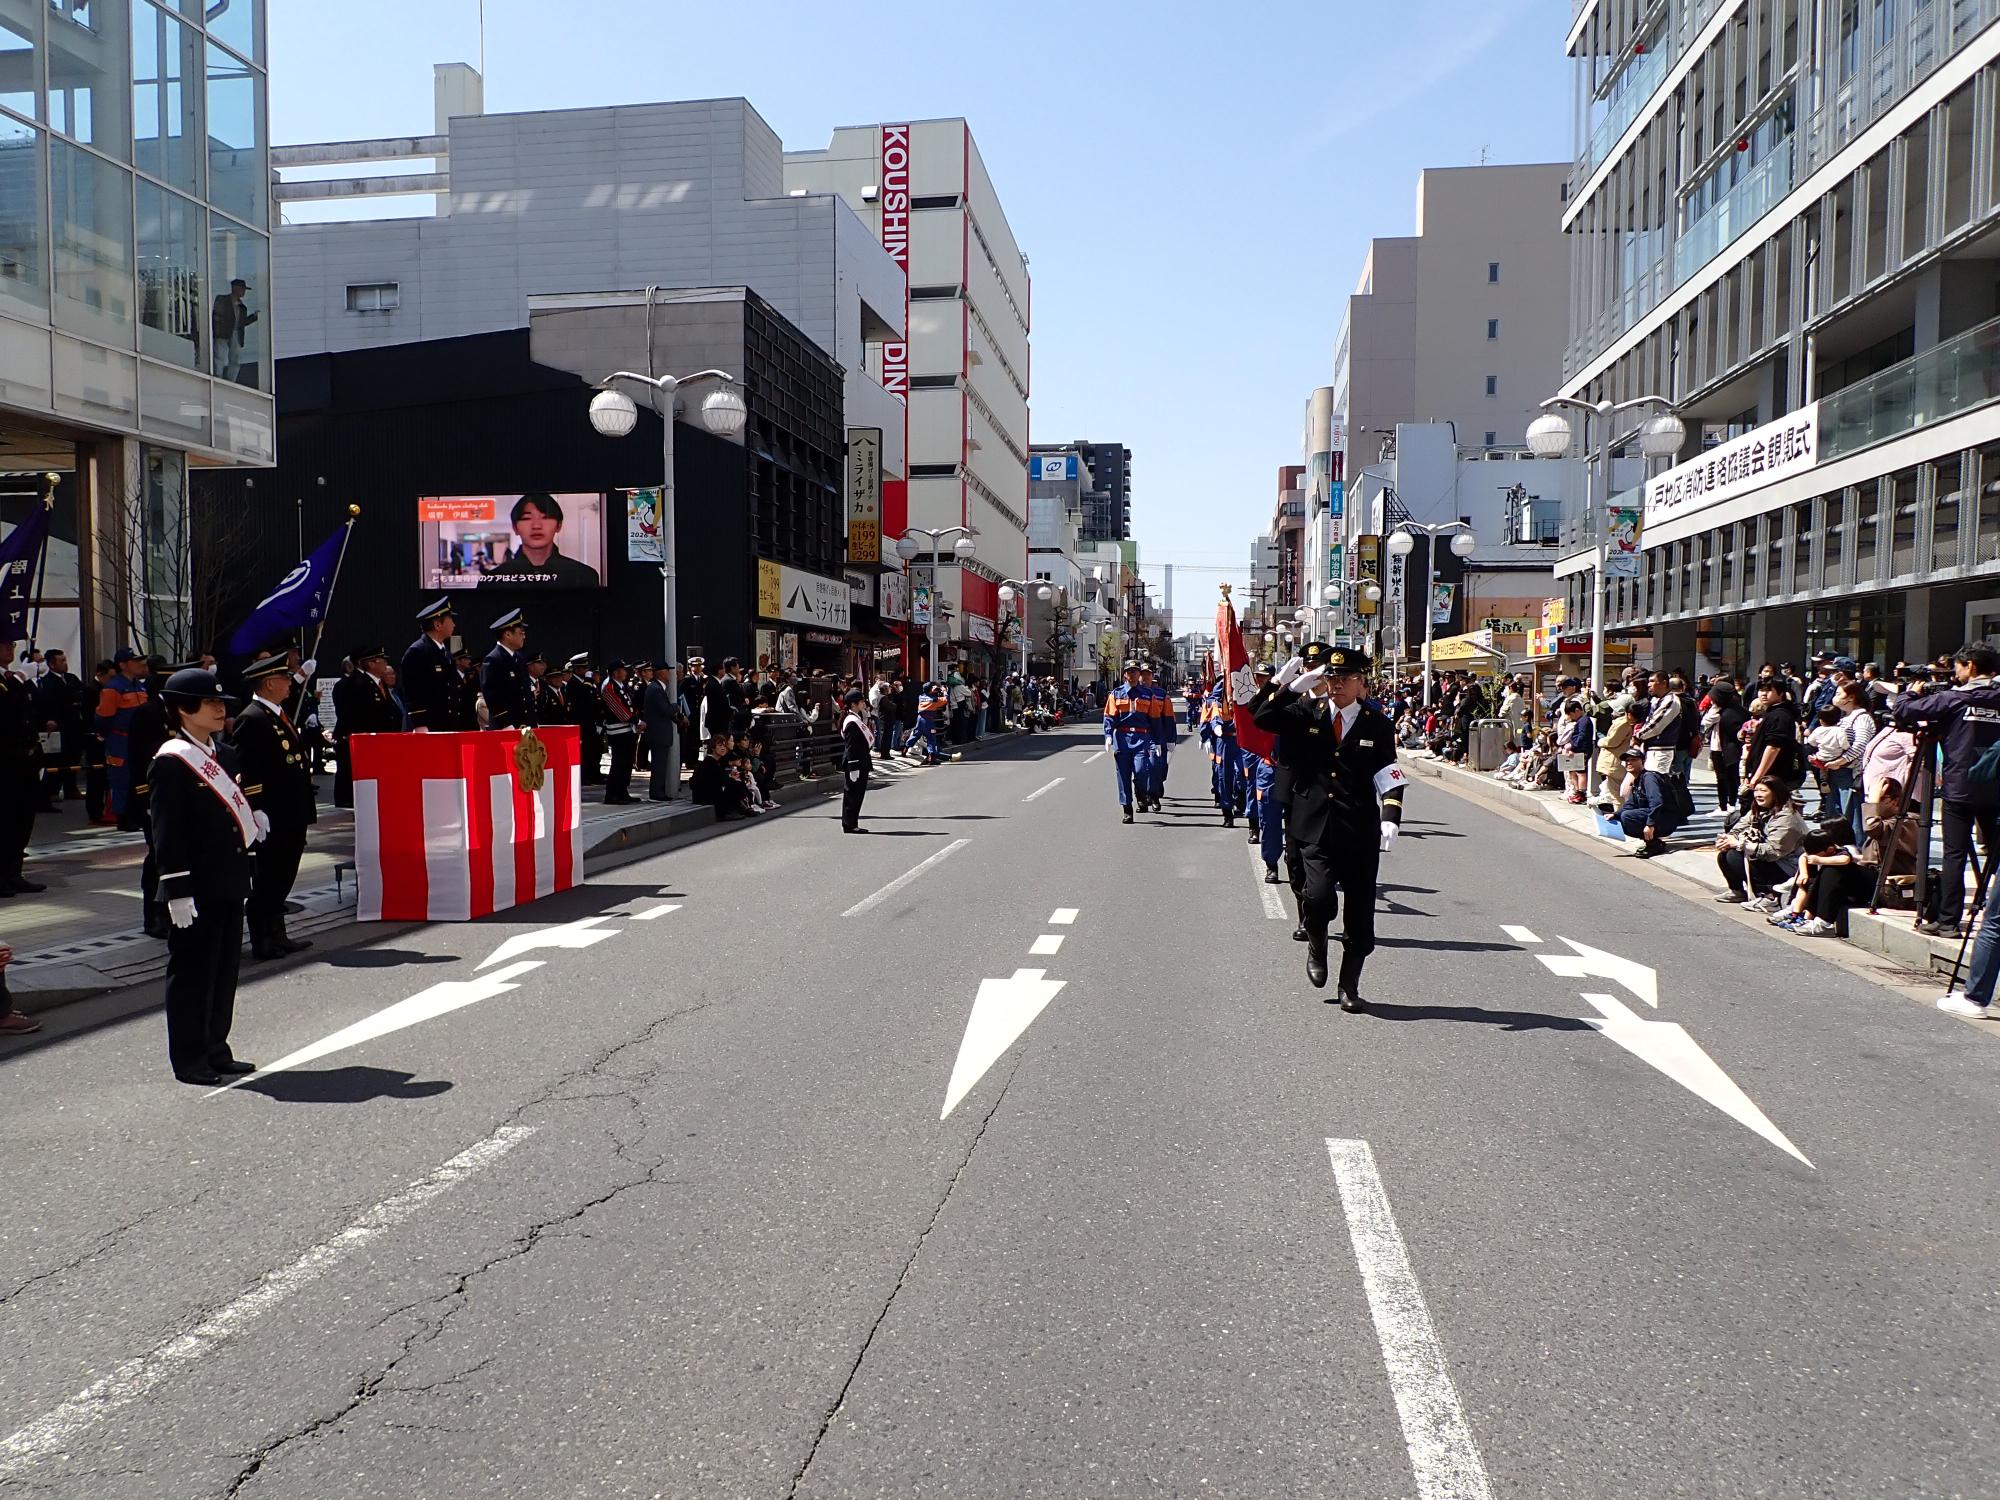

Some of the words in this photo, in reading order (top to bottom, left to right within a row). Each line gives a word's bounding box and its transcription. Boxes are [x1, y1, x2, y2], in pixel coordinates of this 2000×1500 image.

[884, 126, 907, 262] KOUSHIN
[853, 450, 865, 513] ミライザカ
[852, 541, 875, 550] 生ビール
[816, 598, 847, 625] ミライザカ
